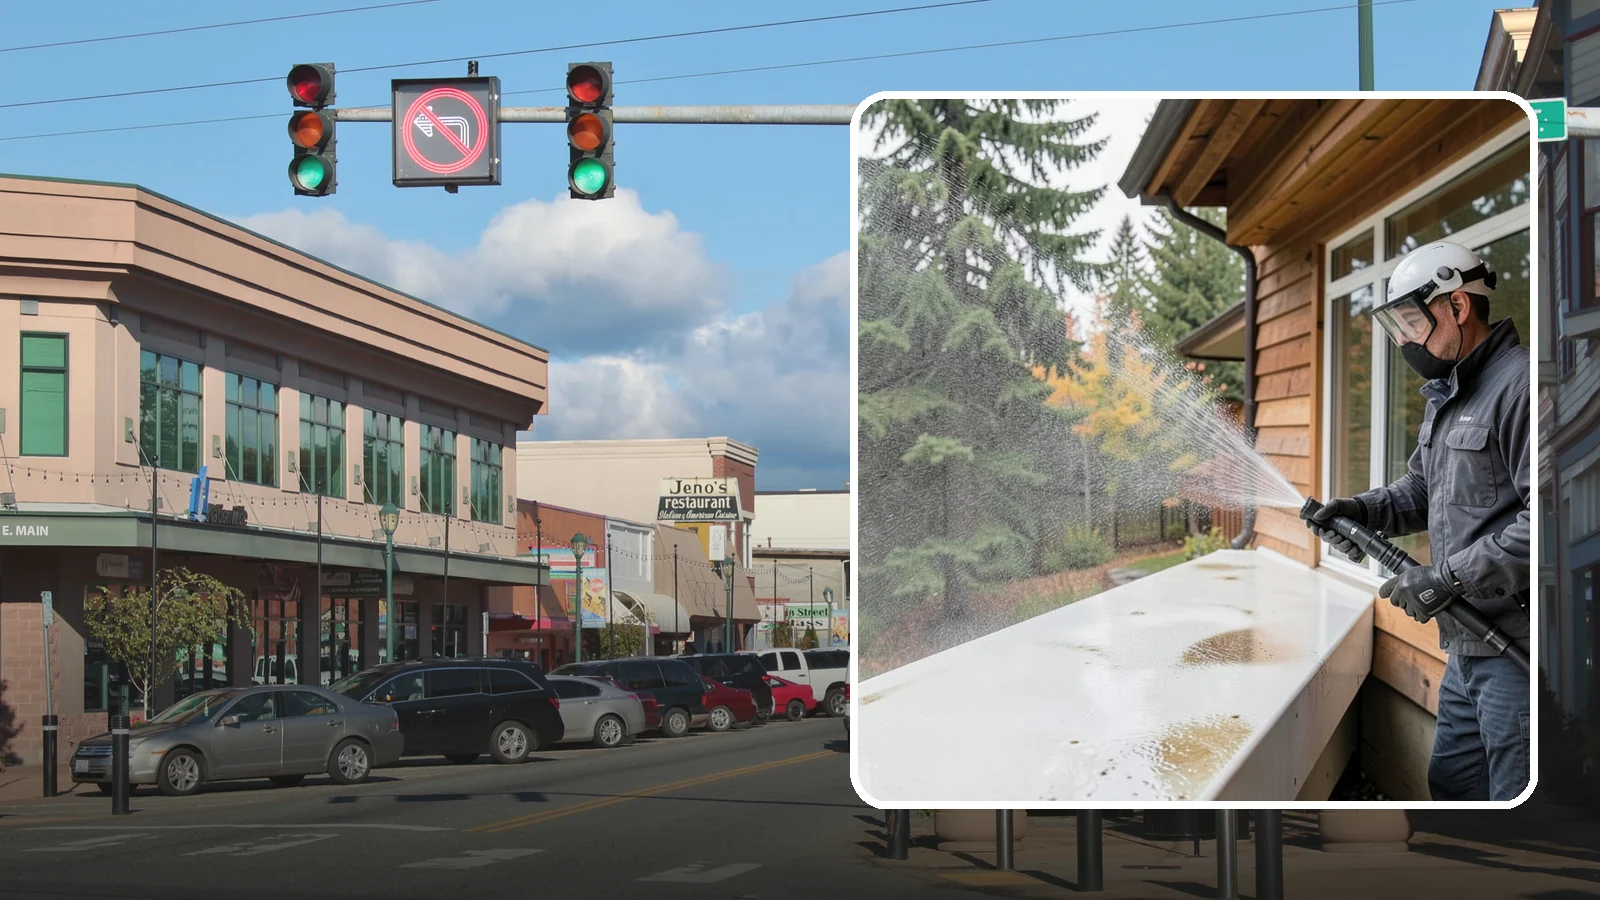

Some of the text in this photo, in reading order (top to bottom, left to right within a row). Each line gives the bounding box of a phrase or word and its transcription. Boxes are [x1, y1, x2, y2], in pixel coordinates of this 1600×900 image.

[669, 480, 727, 494] Jeno's
[665, 496, 731, 509] restaurant
[658, 509, 682, 520] Italian
[685, 509, 714, 519] American
[715, 509, 737, 519] Cuisine
[2, 525, 49, 536] E. MAIN
[797, 607, 828, 617] Street
